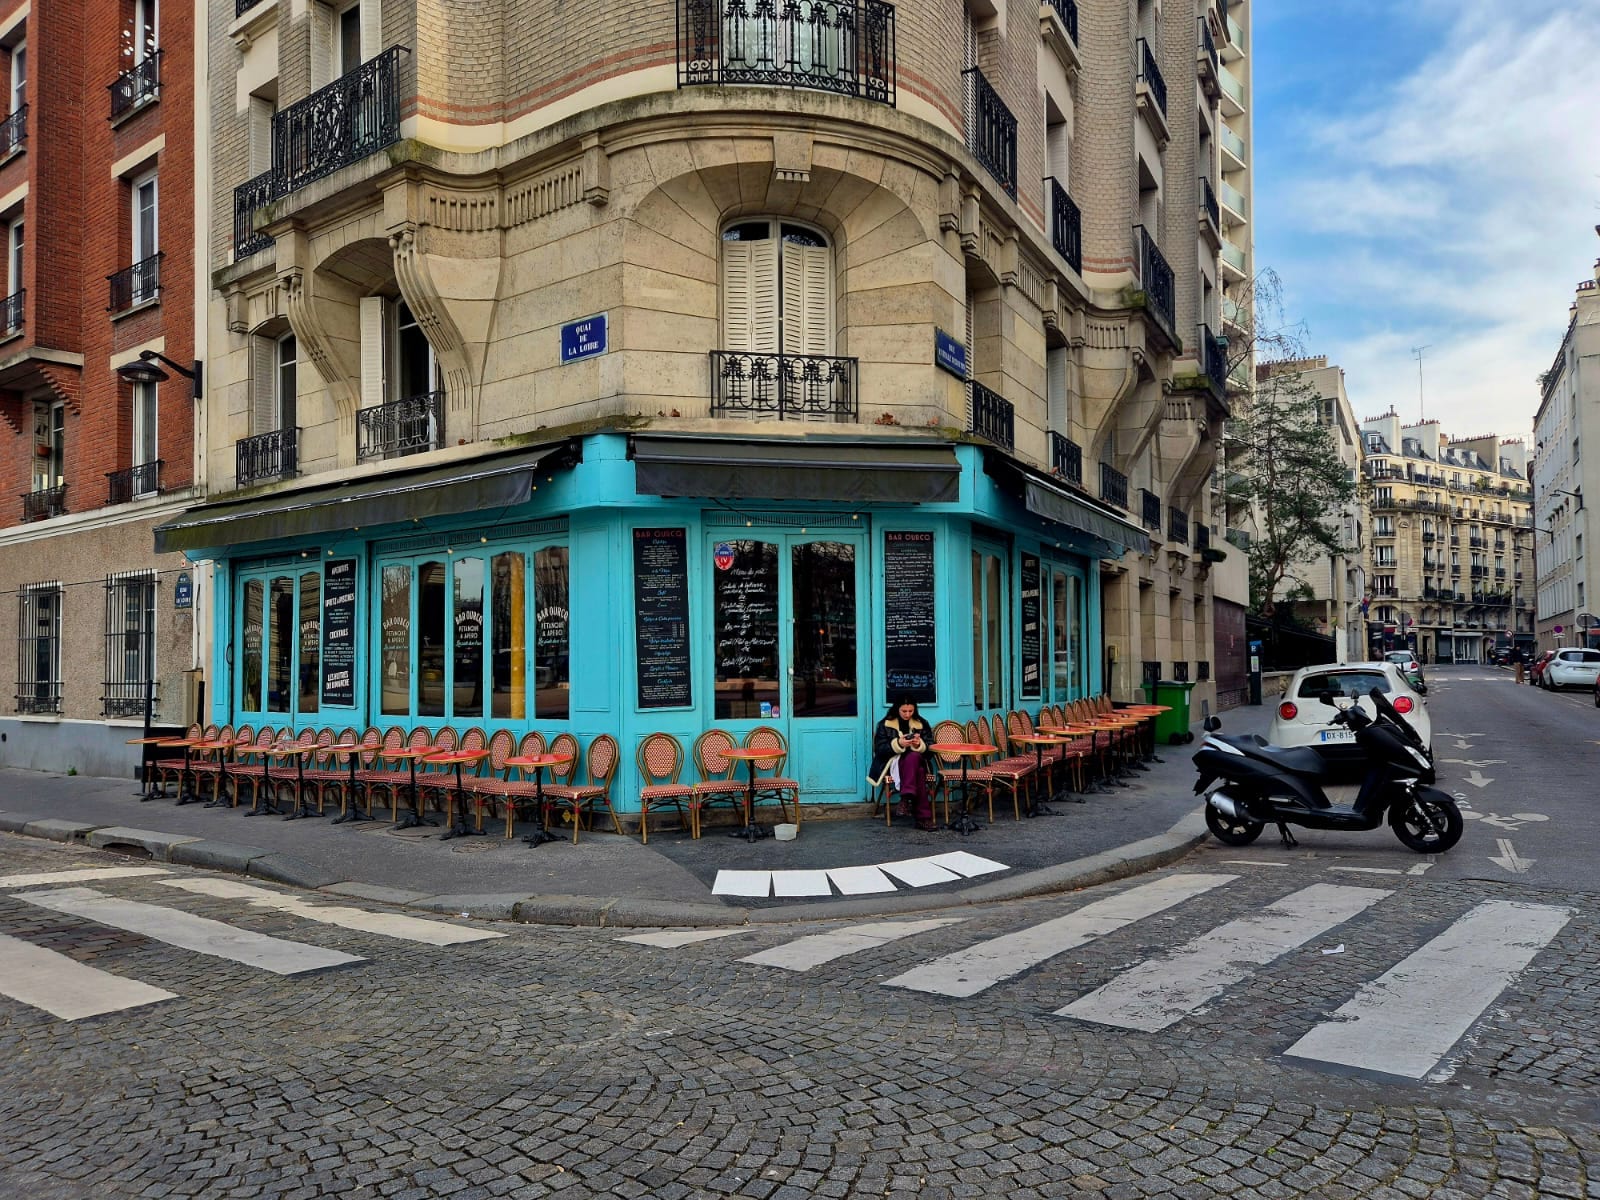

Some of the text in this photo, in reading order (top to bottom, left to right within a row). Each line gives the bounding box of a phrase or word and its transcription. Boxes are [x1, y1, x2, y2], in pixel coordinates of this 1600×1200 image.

[575, 322, 591, 336] QUAI
[579, 334, 588, 343] DE
[568, 341, 599, 356] LA LOIRE
[653, 530, 682, 538] OURCQ
[888, 533, 931, 541] BAR OURCQ
[455, 610, 482, 626] BAR OURCQ
[537, 606, 569, 622] BAR OURCQ
[383, 616, 410, 630] BAR OURCQ
